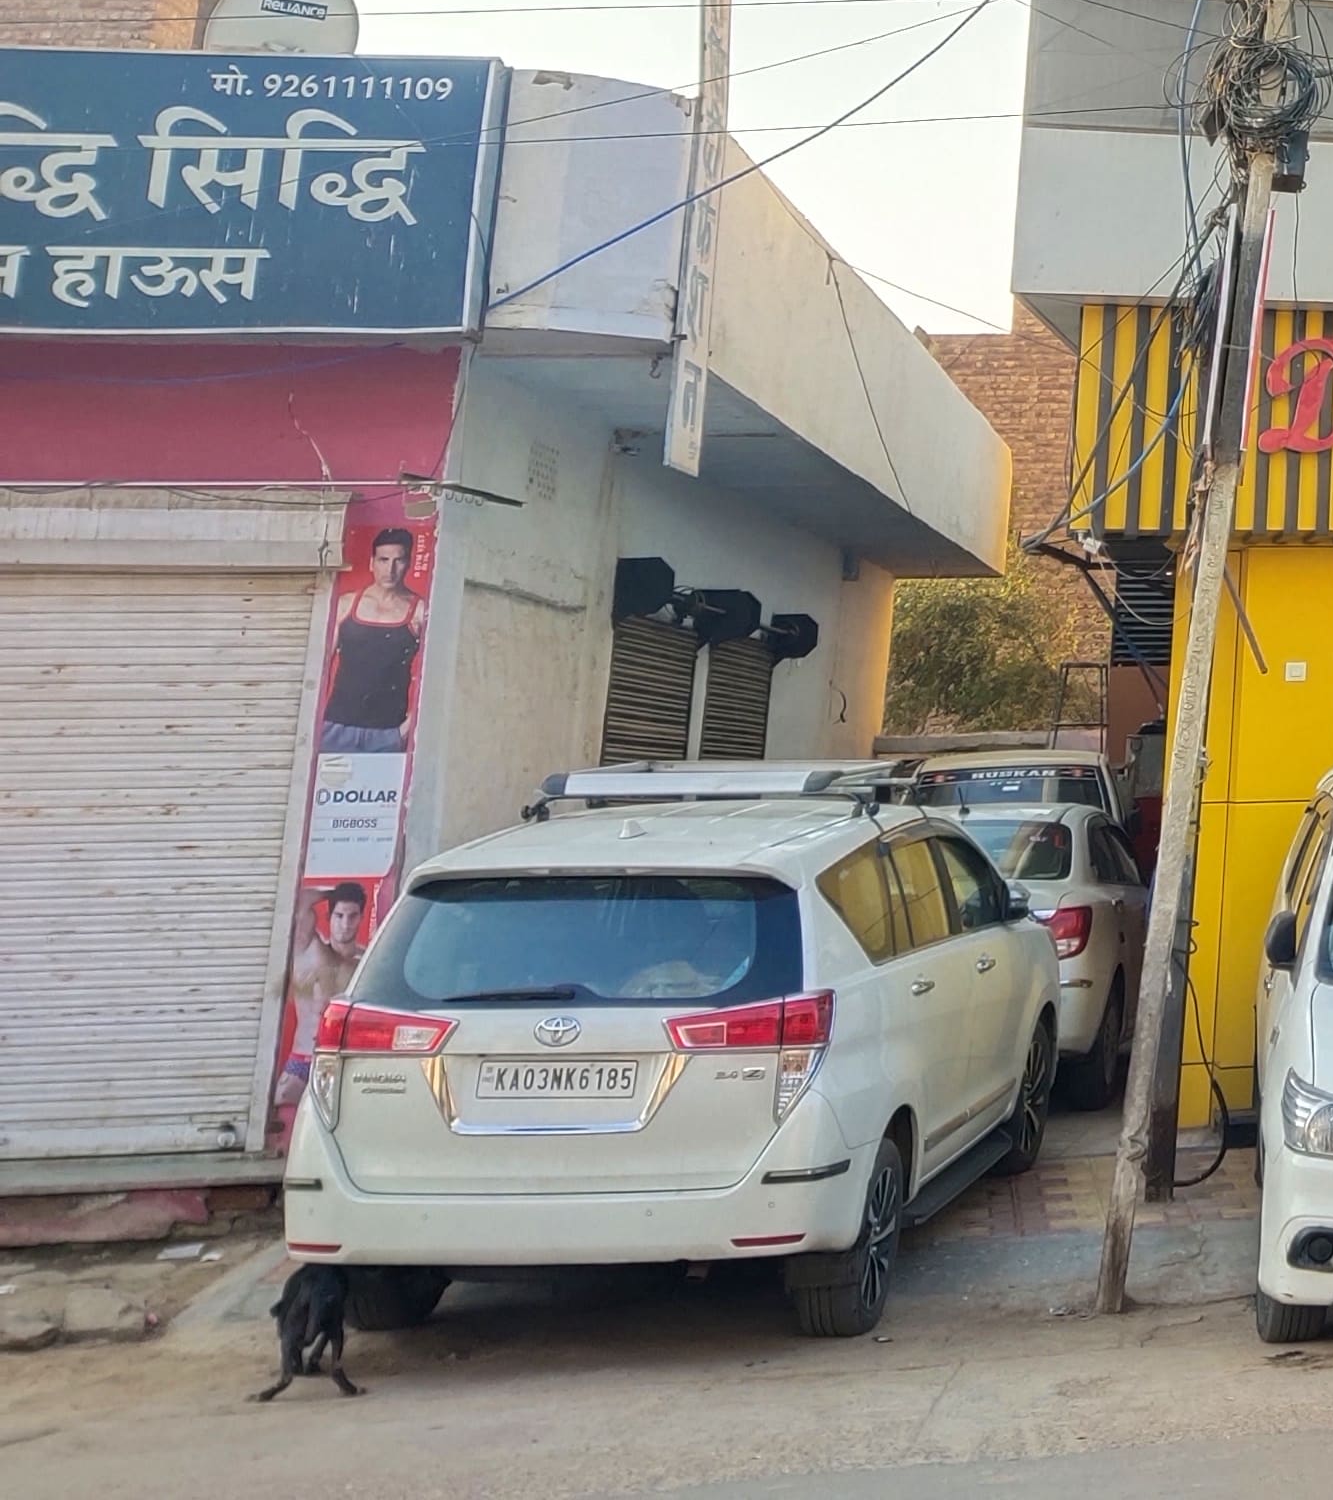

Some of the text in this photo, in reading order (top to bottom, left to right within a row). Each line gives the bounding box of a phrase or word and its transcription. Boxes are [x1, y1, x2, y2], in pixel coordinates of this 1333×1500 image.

[211, 64, 454, 100] मो. 9261111109
[0, 103, 427, 226] द्धि सिद्धि
[45, 245, 271, 308] हाऊस
[332, 790, 398, 804] DOLLAR
[332, 818, 378, 829] BIGBOSS
[494, 1066, 633, 1091] KA03NK6185
